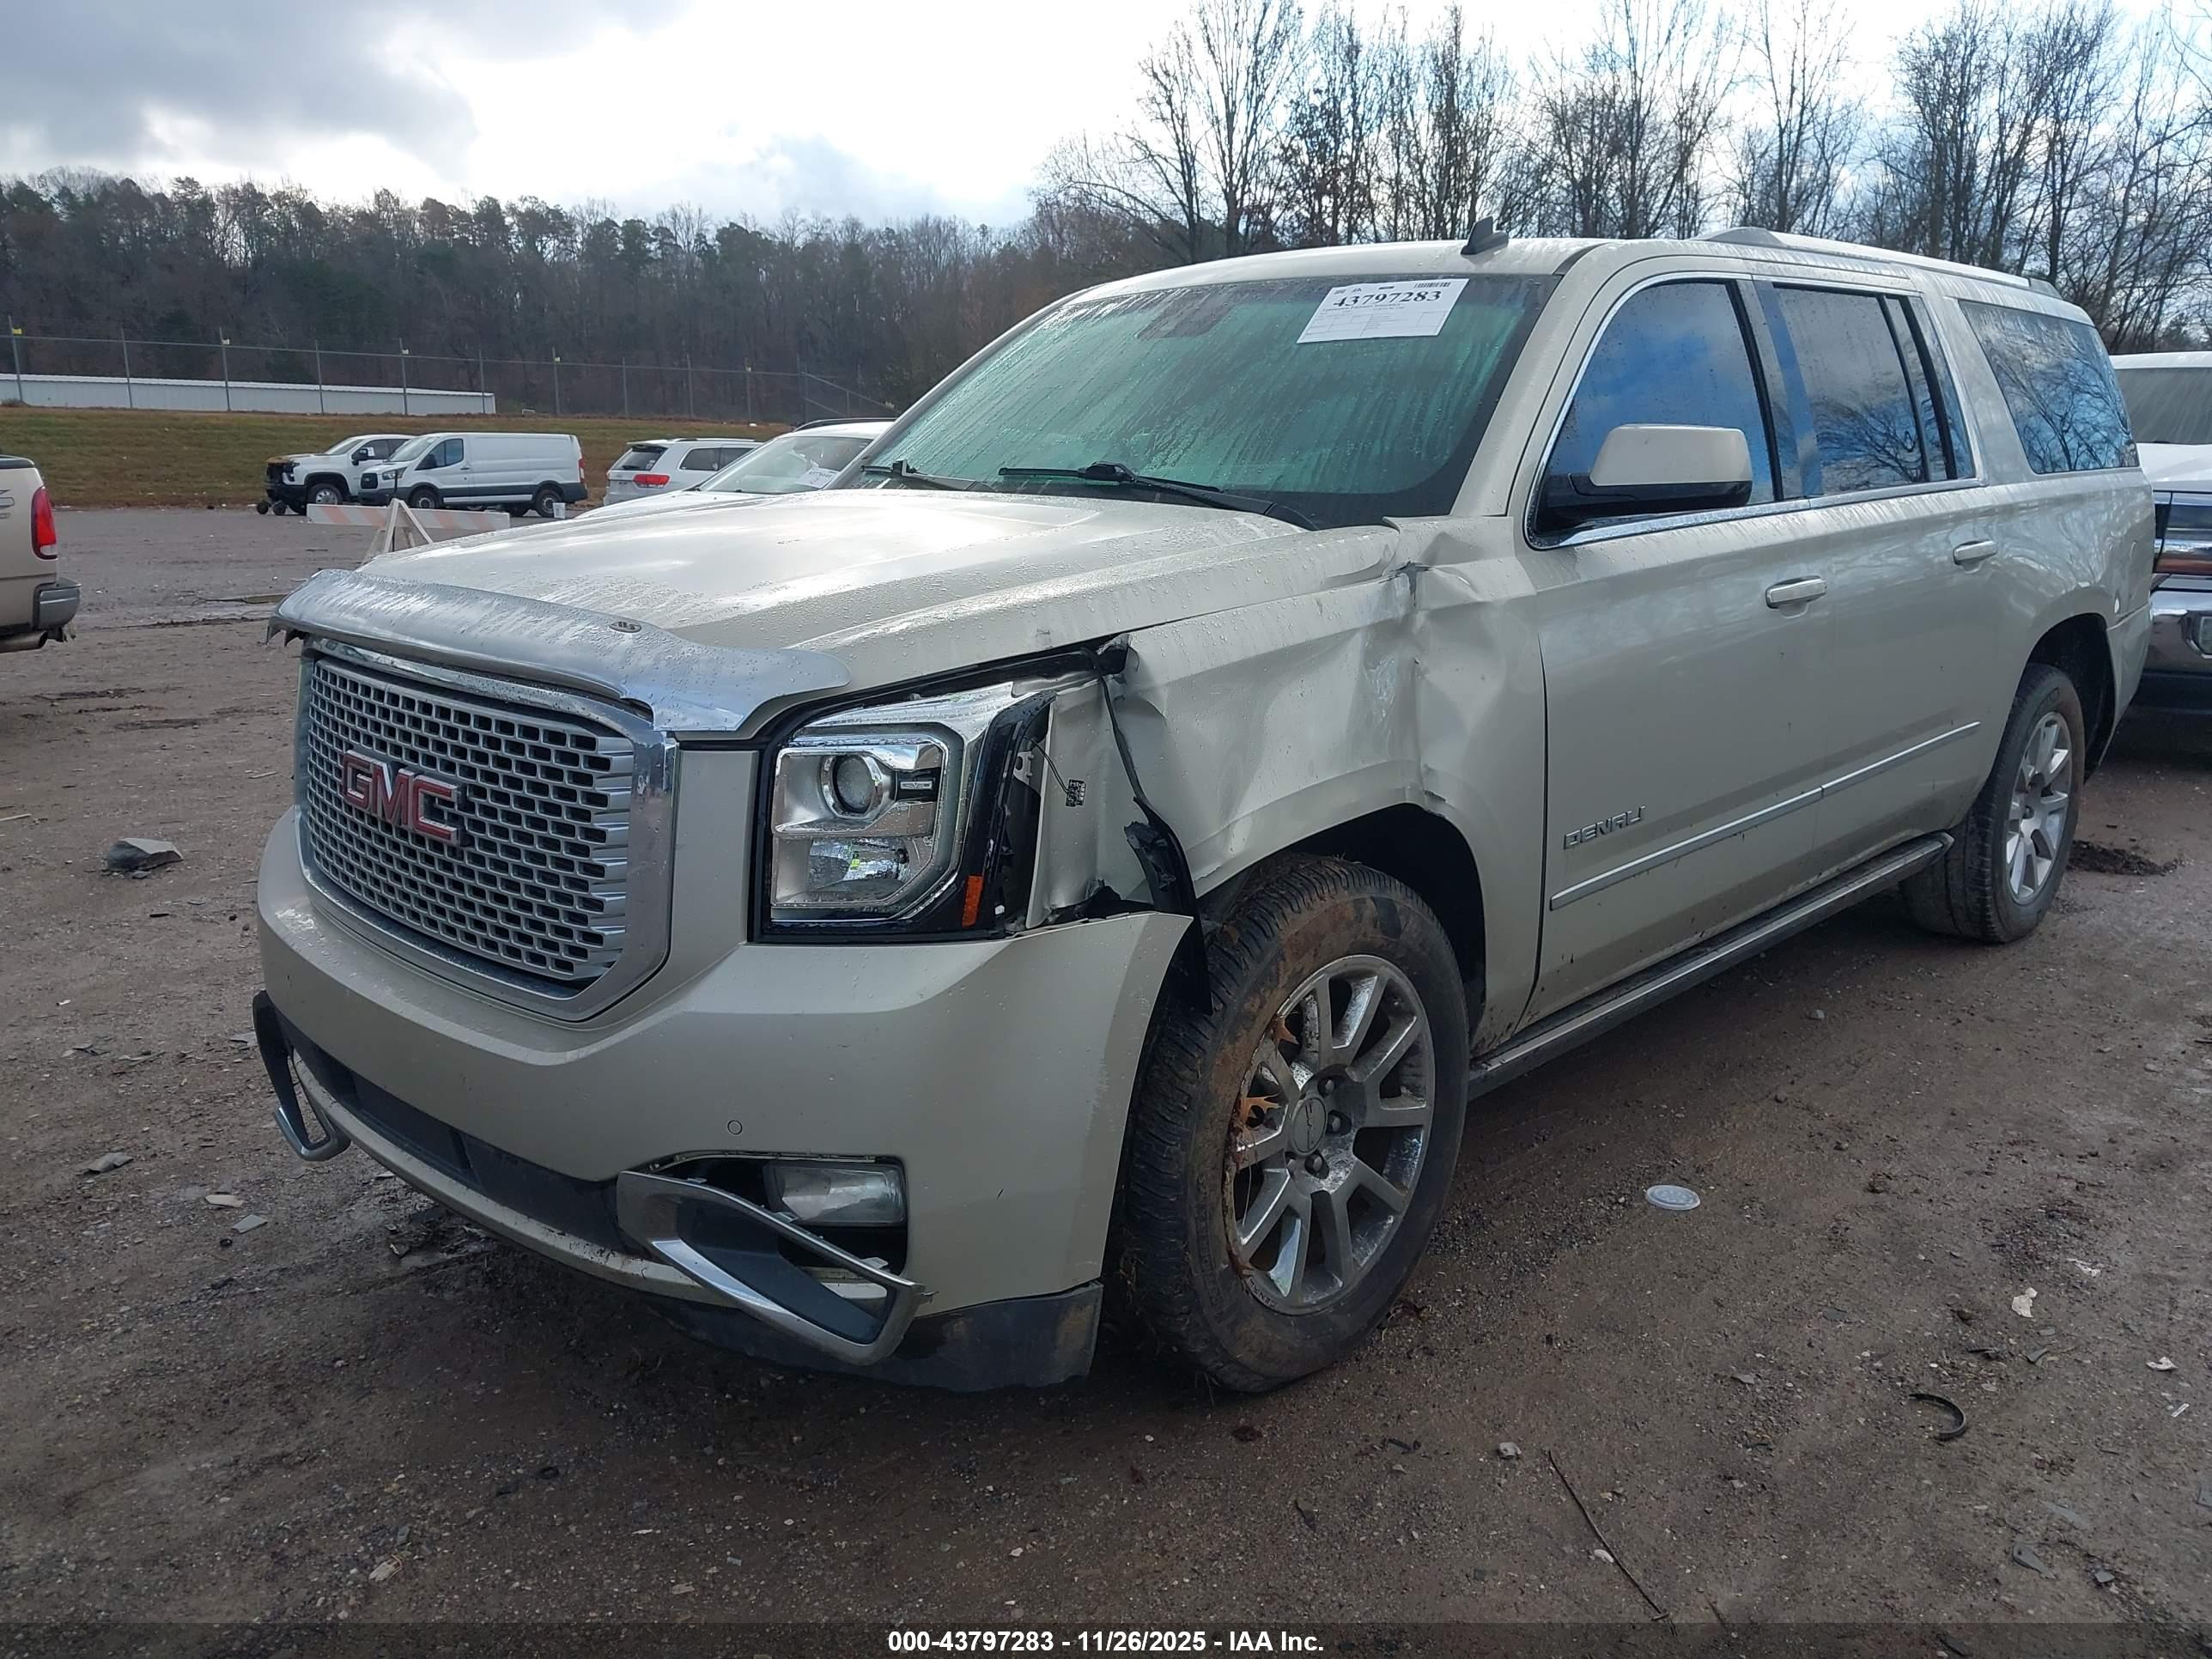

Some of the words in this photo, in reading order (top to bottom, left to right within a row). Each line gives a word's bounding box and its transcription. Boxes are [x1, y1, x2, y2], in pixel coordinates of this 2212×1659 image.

[1334, 290, 1442, 307] 43797283
[342, 749, 461, 846] GMC
[1563, 805, 1647, 850] DENALI
